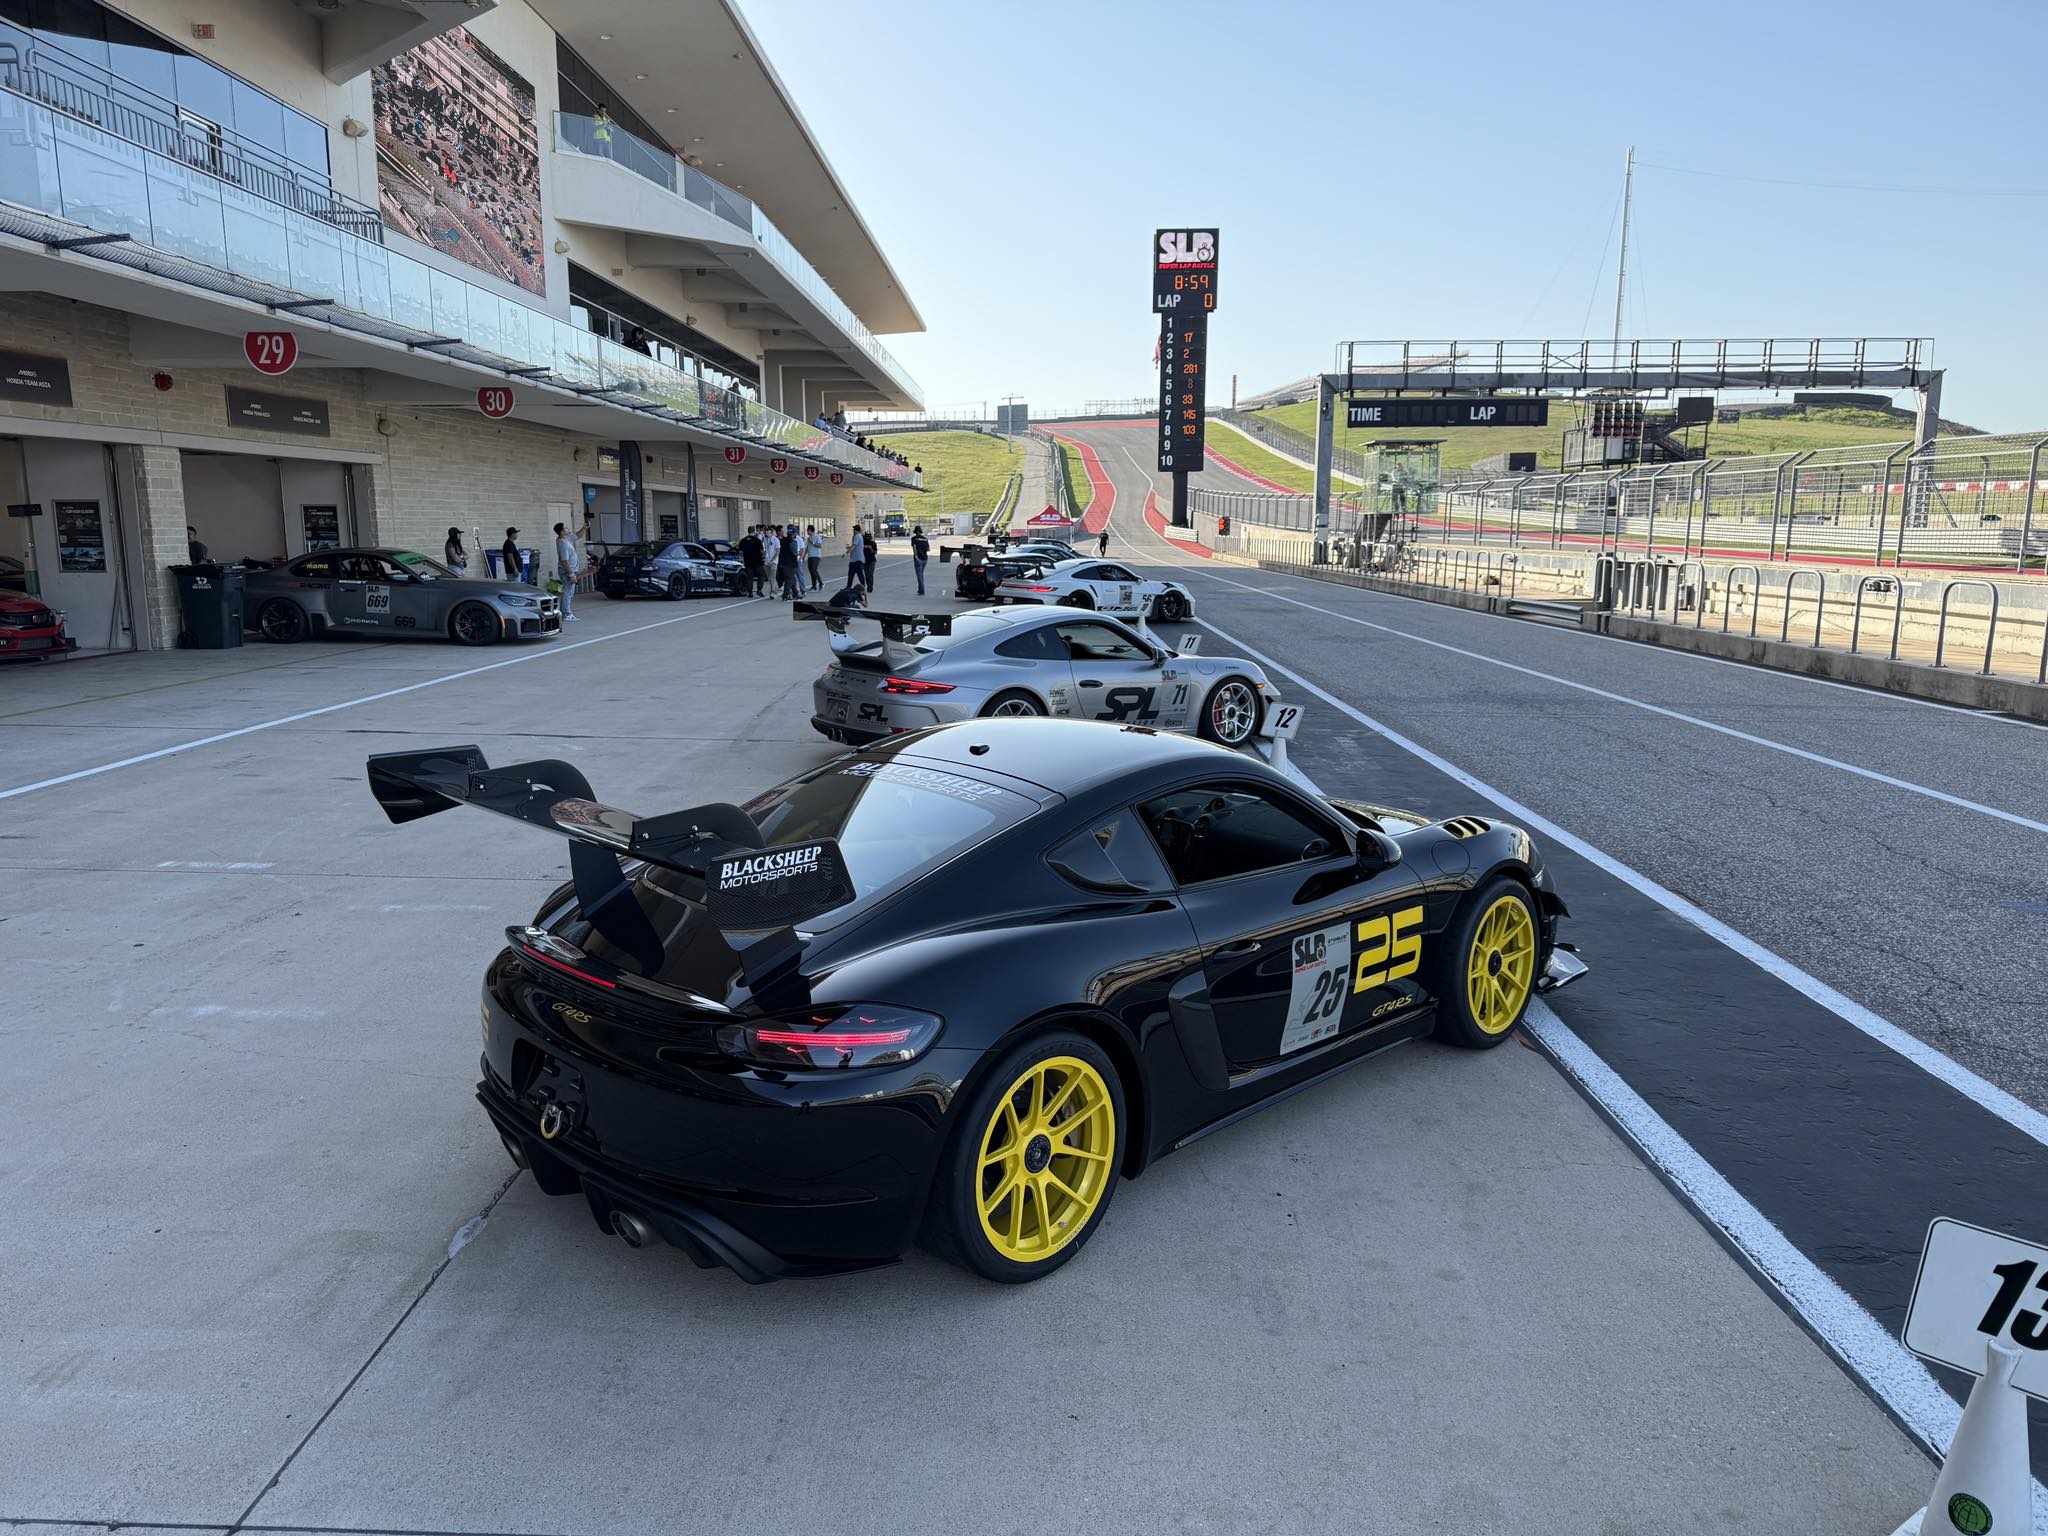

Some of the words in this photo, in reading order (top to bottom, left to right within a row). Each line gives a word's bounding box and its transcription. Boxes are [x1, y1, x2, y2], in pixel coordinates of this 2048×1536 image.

[1159, 232, 1215, 263] SLB
[1174, 275, 1209, 290] 8:59
[1157, 294, 1181, 308] LAP
[1204, 293, 1213, 308] 0
[1167, 317, 1173, 328] 1
[1166, 333, 1174, 344] 2
[1184, 332, 1194, 343] 17
[256, 335, 285, 365] 29
[1166, 348, 1173, 359] 3
[1183, 348, 1190, 359] 2
[1165, 364, 1173, 375] 4
[1183, 364, 1198, 374] 281
[6, 377, 24, 385] HONDA
[24, 379, 39, 387] TEAM
[1165, 379, 1173, 390] 5
[486, 391, 506, 411] 30
[1165, 394, 1172, 406] 6
[1182, 394, 1193, 405] 33
[1164, 410, 1172, 421] 7
[1349, 407, 1382, 422] TIME
[1470, 406, 1497, 421] LAP
[1164, 425, 1171, 436] 8
[1182, 425, 1196, 435] 103
[1164, 440, 1171, 451] 9
[729, 448, 740, 460] 31
[1160, 455, 1173, 466] 10
[774, 460, 785, 471] 32
[807, 468, 817, 478] 33
[833, 474, 841, 483] 34
[367, 595, 389, 608] 669
[394, 616, 417, 629] 669
[913, 625, 931, 635] SPL
[1185, 637, 1197, 649] 11
[1172, 685, 1188, 705] 71
[1095, 687, 1160, 720] SPL
[857, 703, 888, 721] SPL
[1275, 708, 1297, 729] 12
[838, 769, 982, 801] MOTORSPORTS
[849, 762, 1003, 796] BLACKSHEEP
[720, 846, 822, 879] BLACKSHEEP
[720, 862, 818, 890] MOTORSPORTS
[1294, 933, 1327, 968] SLB
[1353, 905, 1424, 994] 25
[1302, 964, 1349, 1025] 25
[552, 1002, 593, 1023] GT4RS
[1372, 994, 1413, 1017] GT4RS
